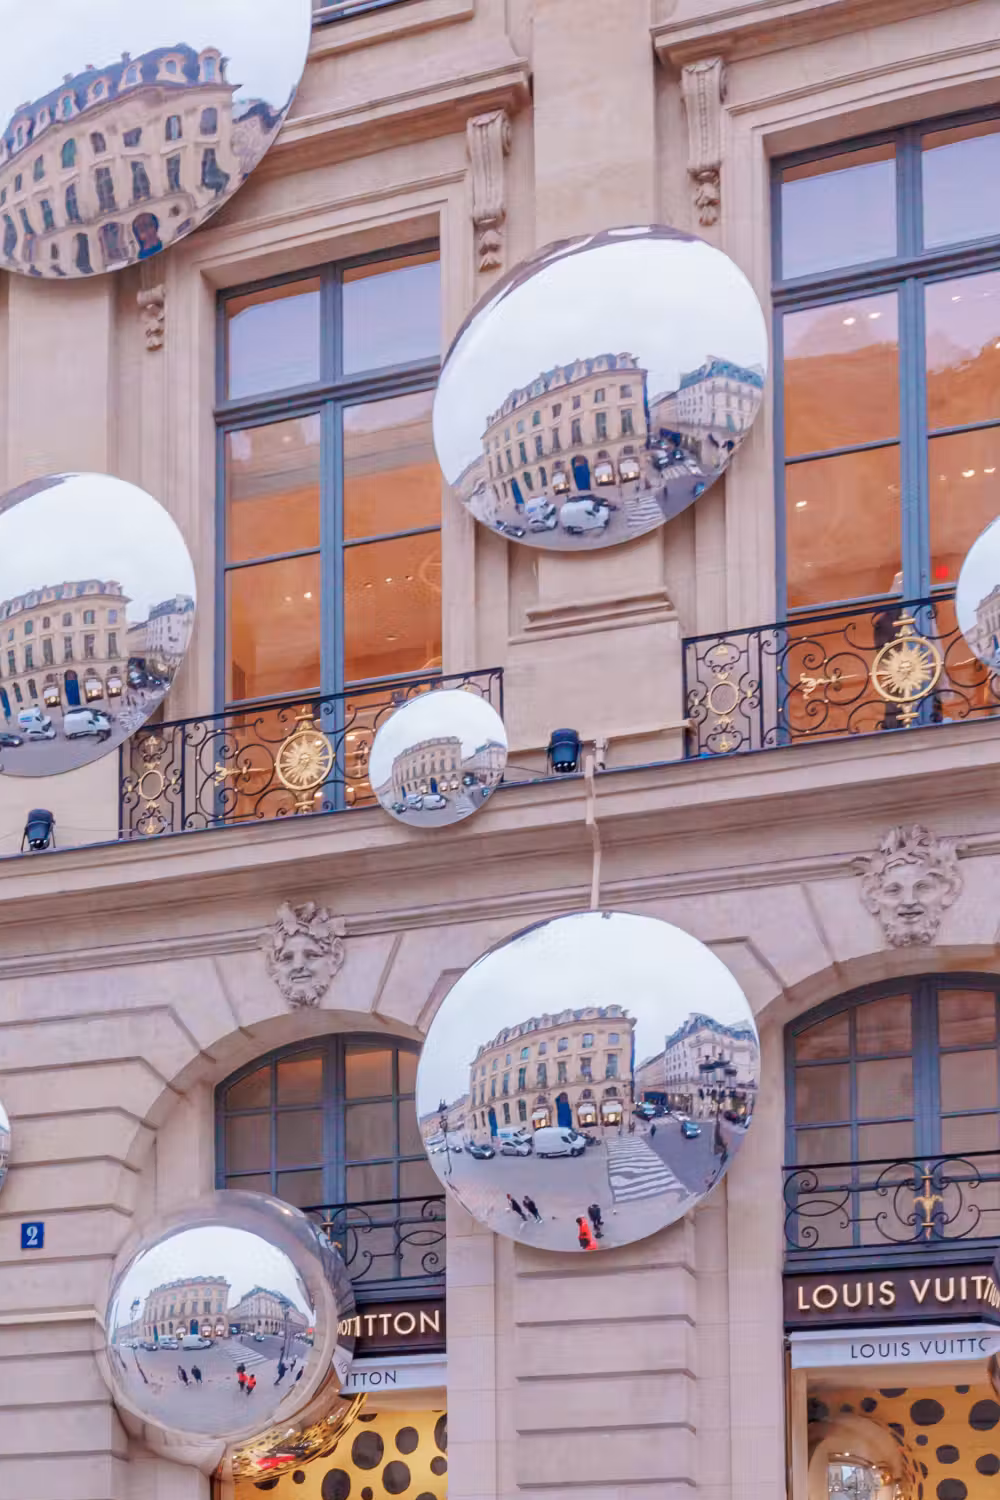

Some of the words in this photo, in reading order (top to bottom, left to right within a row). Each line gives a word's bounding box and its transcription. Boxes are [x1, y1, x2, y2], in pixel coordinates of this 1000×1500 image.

[26, 1226, 38, 1246] 2
[798, 1281, 896, 1310] LOUIS
[851, 1342, 910, 1359] LOUIS
